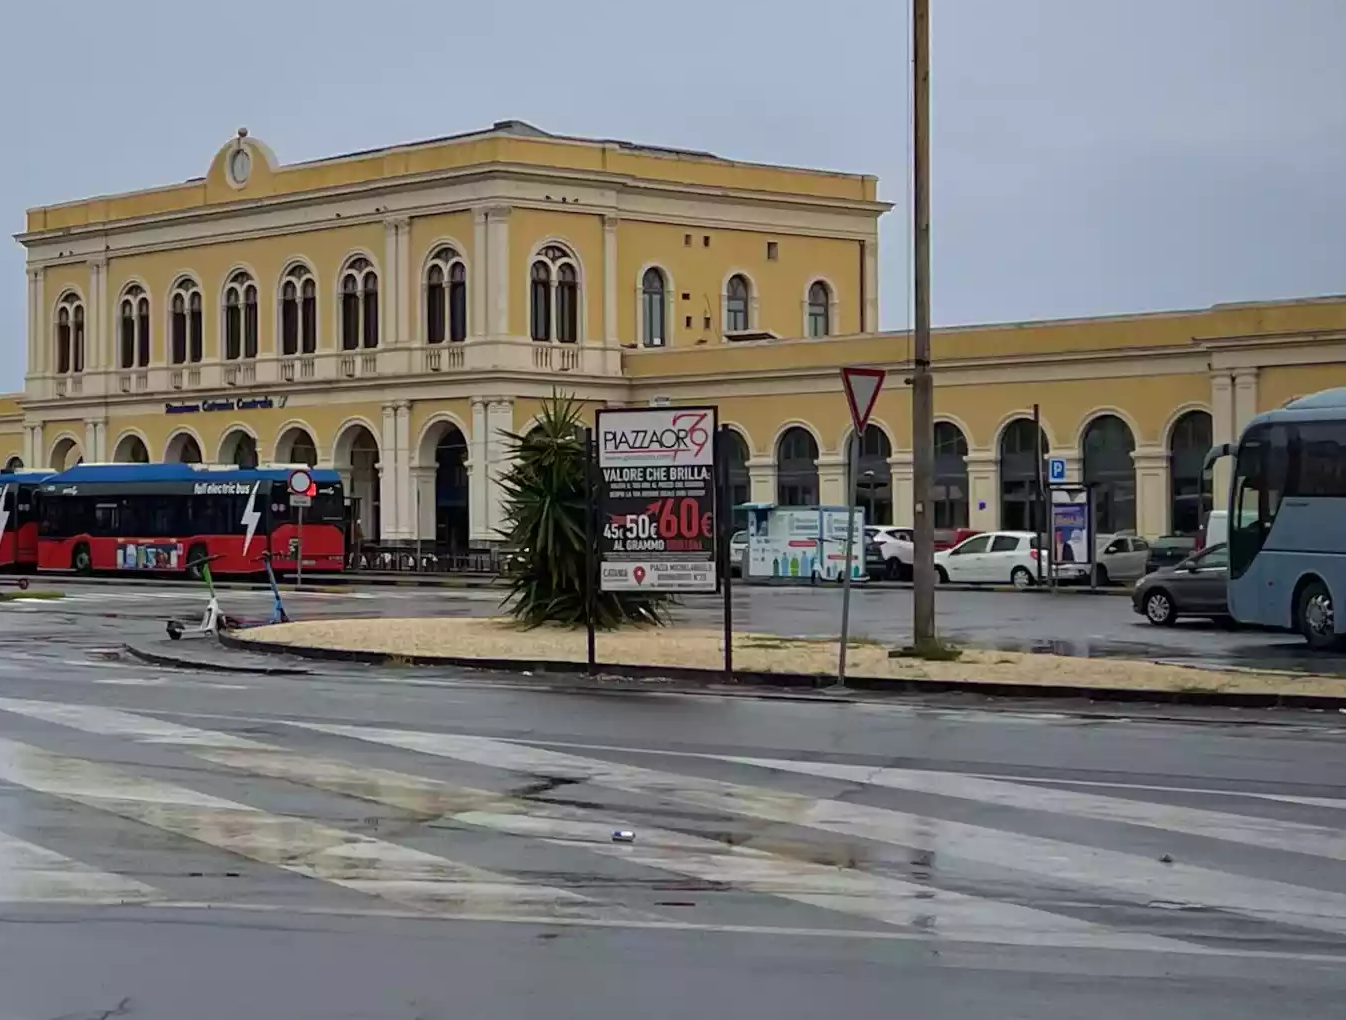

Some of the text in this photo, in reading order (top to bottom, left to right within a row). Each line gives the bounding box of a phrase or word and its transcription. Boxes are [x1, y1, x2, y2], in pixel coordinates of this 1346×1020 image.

[603, 467, 644, 482] VALORE
[646, 467, 668, 481] CHE
[1053, 462, 1063, 476] P
[207, 482, 236, 494] electric
[236, 482, 251, 494] bus
[626, 514, 659, 539] 50€
[659, 497, 713, 538] 60€
[613, 540, 625, 551] AL
[626, 540, 665, 551] GRAMMO
